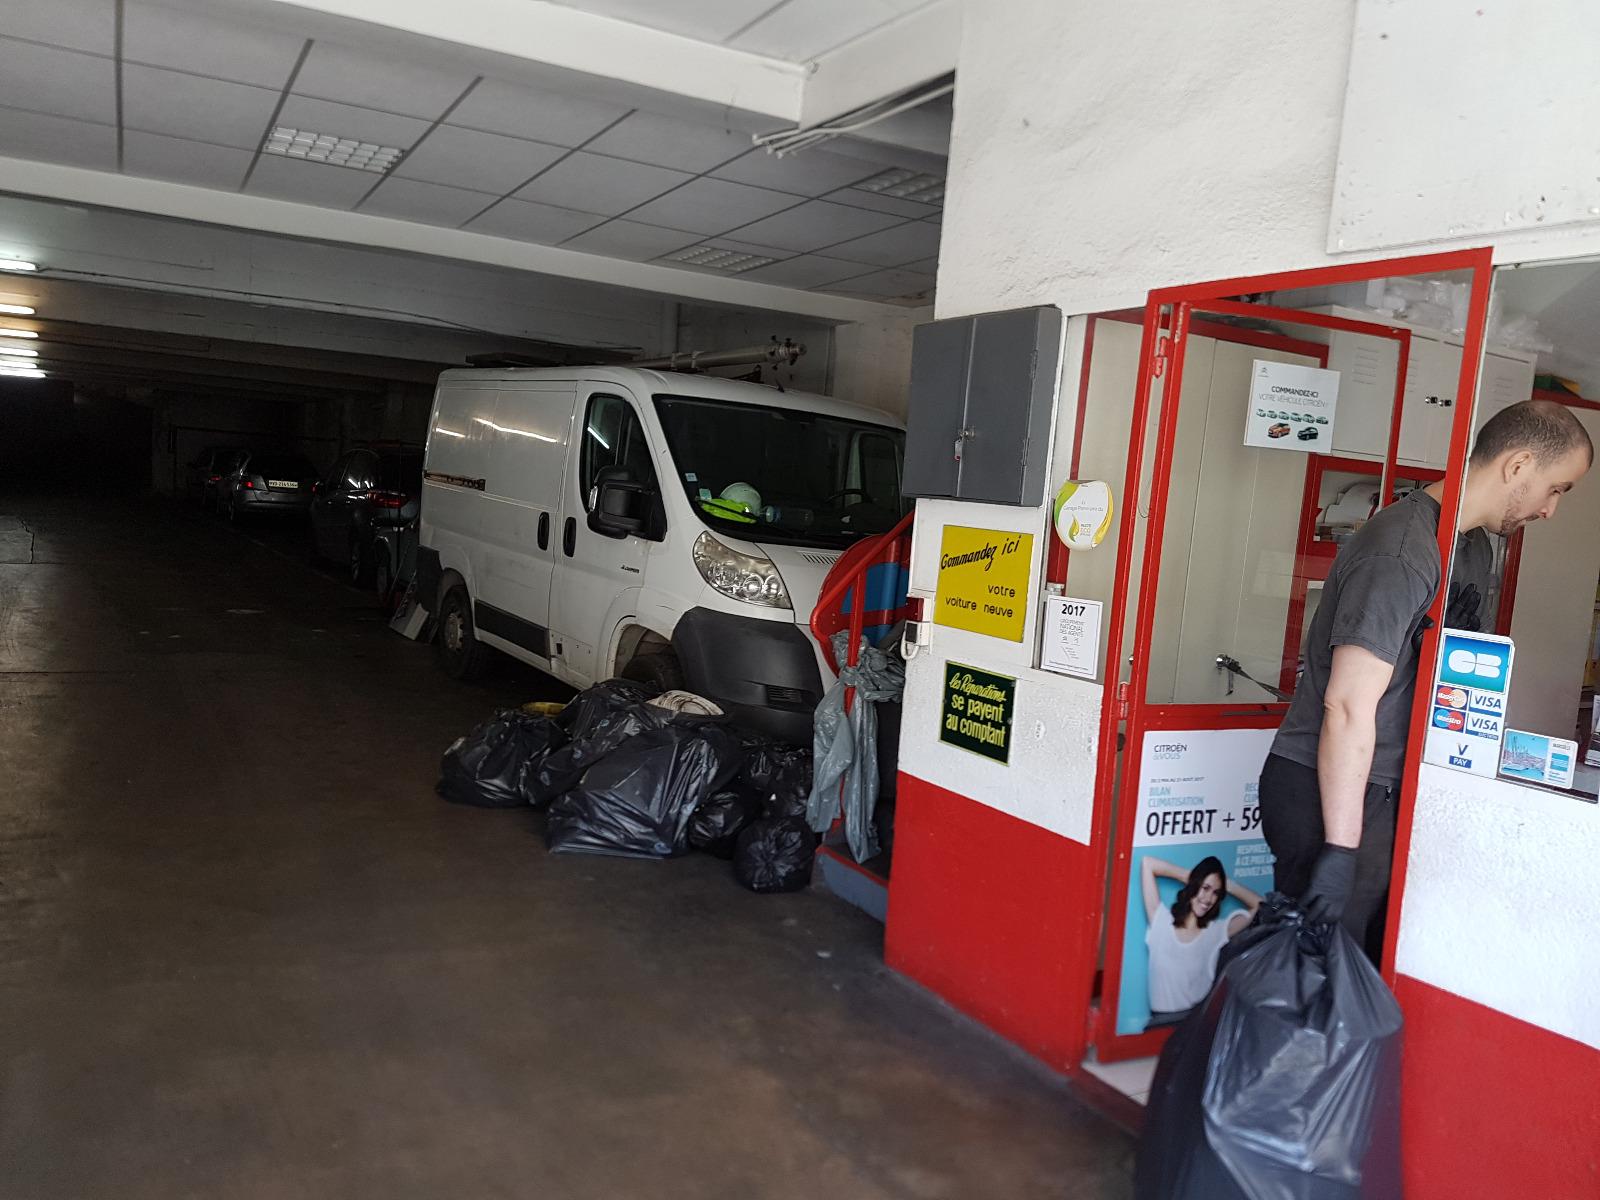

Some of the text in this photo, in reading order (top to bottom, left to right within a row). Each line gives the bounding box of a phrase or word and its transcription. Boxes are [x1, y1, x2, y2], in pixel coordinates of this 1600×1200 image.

[941, 535, 1022, 571] Commandez ici
[988, 584, 1016, 598] votre
[945, 597, 1013, 617] voiture neuve
[1061, 603, 1086, 616] 2017
[960, 673, 1007, 702] Réparations
[951, 694, 1004, 723] se payent
[1475, 695, 1502, 709] VISA
[946, 714, 1006, 747] au comptant
[1472, 718, 1498, 732] VISA
[1154, 743, 1188, 752] CITROËN
[1457, 742, 1469, 756] V
[1453, 757, 1468, 767] PAY
[1149, 786, 1171, 796] BILAN
[1148, 796, 1205, 808] CLIMATISATION
[1146, 809, 1218, 837] OFFERT
